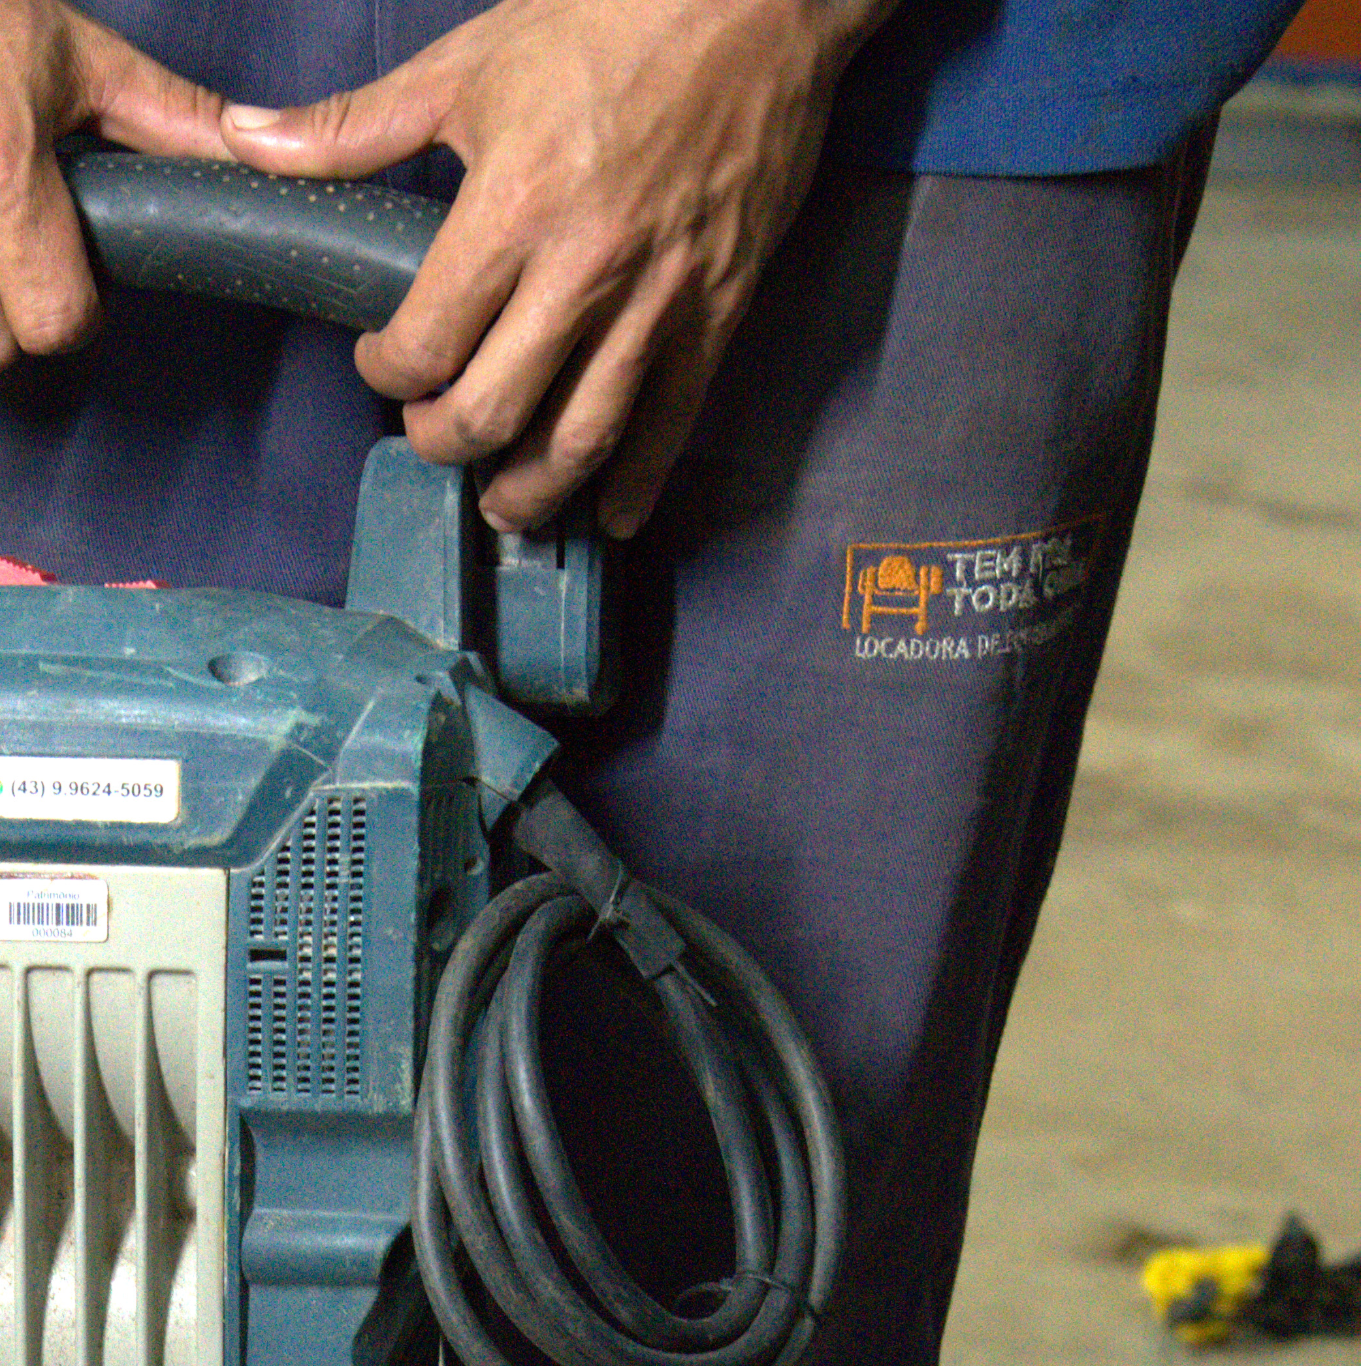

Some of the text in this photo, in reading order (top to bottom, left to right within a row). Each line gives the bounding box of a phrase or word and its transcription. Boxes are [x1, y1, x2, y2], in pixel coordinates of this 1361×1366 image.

[946, 546, 1022, 581] TEM
[946, 579, 1037, 617] TODA
[855, 635, 972, 660] LOCADORA
[10, 779, 165, 799] (43) 9.9624-5059
[31, 928, 73, 938] 000084
